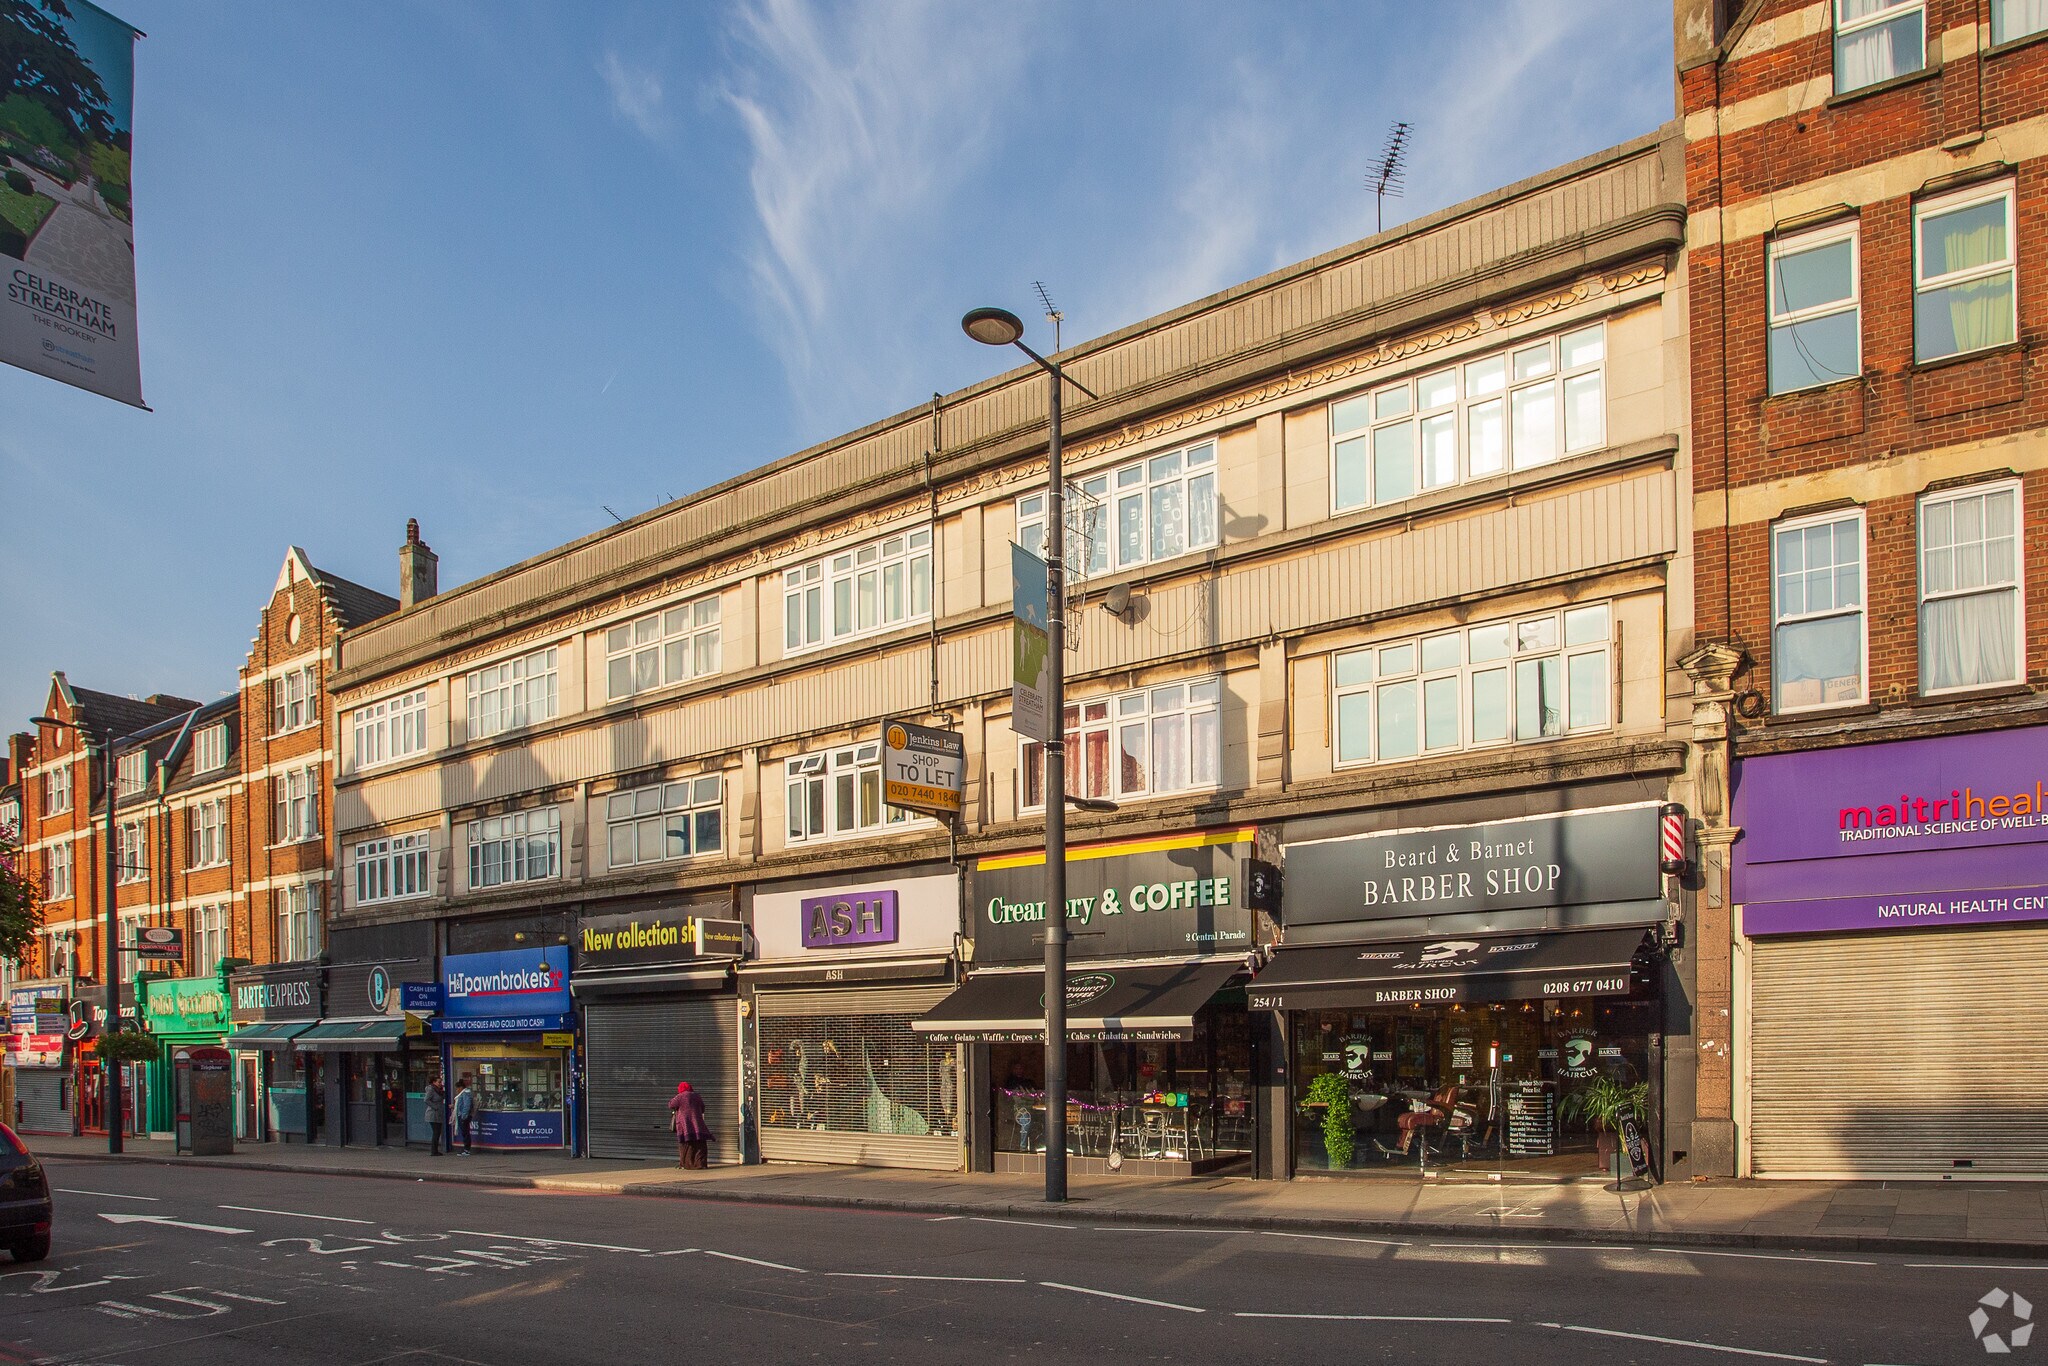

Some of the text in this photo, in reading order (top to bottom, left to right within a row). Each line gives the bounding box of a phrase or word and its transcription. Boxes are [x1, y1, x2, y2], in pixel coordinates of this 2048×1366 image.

[13, 269, 112, 320] CELEBRATE
[8, 283, 117, 337] STREATHAM
[32, 313, 98, 344] THE ROOKERY
[909, 733, 960, 751] Jenkins Law
[912, 753, 940, 767] SHOP
[897, 763, 955, 787] TO LET
[891, 784, 960, 804] 020 7440 1840
[1840, 828, 1921, 842] TRADITIONAL
[1924, 821, 1978, 835] SCIENCE
[1980, 820, 1998, 830] OF
[1384, 838, 1533, 869] Beard & Barnet
[1363, 864, 1561, 906] BARBER SHOP
[987, 896, 1097, 926] Creary
[1100, 888, 1124, 915] &
[1129, 877, 1232, 913] COFFEE
[1878, 902, 1945, 918] NATURAL
[1950, 899, 2008, 914] HEALTH
[809, 900, 883, 940] ASH
[584, 928, 614, 951] New
[616, 920, 678, 948] collection
[1185, 930, 1246, 942] 2 Central Parade
[1488, 942, 1538, 953] BARNET
[1393, 959, 1478, 969] HAIRCUT
[825, 970, 843, 980] ASH
[1375, 988, 1457, 1001] BARBER SHOP
[1543, 979, 1624, 994] 0208 677 0410
[1253, 998, 1270, 1007] 254
[93, 1004, 136, 1027] Top izza
[453, 1021, 467, 1029] YOUR
[467, 1021, 489, 1029] CHEQUES
[1557, 1027, 1599, 1038] BARBER
[929, 1033, 949, 1042] Coffee
[954, 1033, 976, 1042] Gelato
[982, 1033, 1005, 1041] Waffle
[1011, 1033, 1033, 1043] Crepes
[1070, 1032, 1090, 1040] Cakes
[1098, 1031, 1128, 1040] Ciabatta
[1136, 1031, 1181, 1040] Sandwiches
[1338, 1069, 1373, 1080] HAIRCUT
[1557, 1066, 1599, 1078] HAIRCUT
